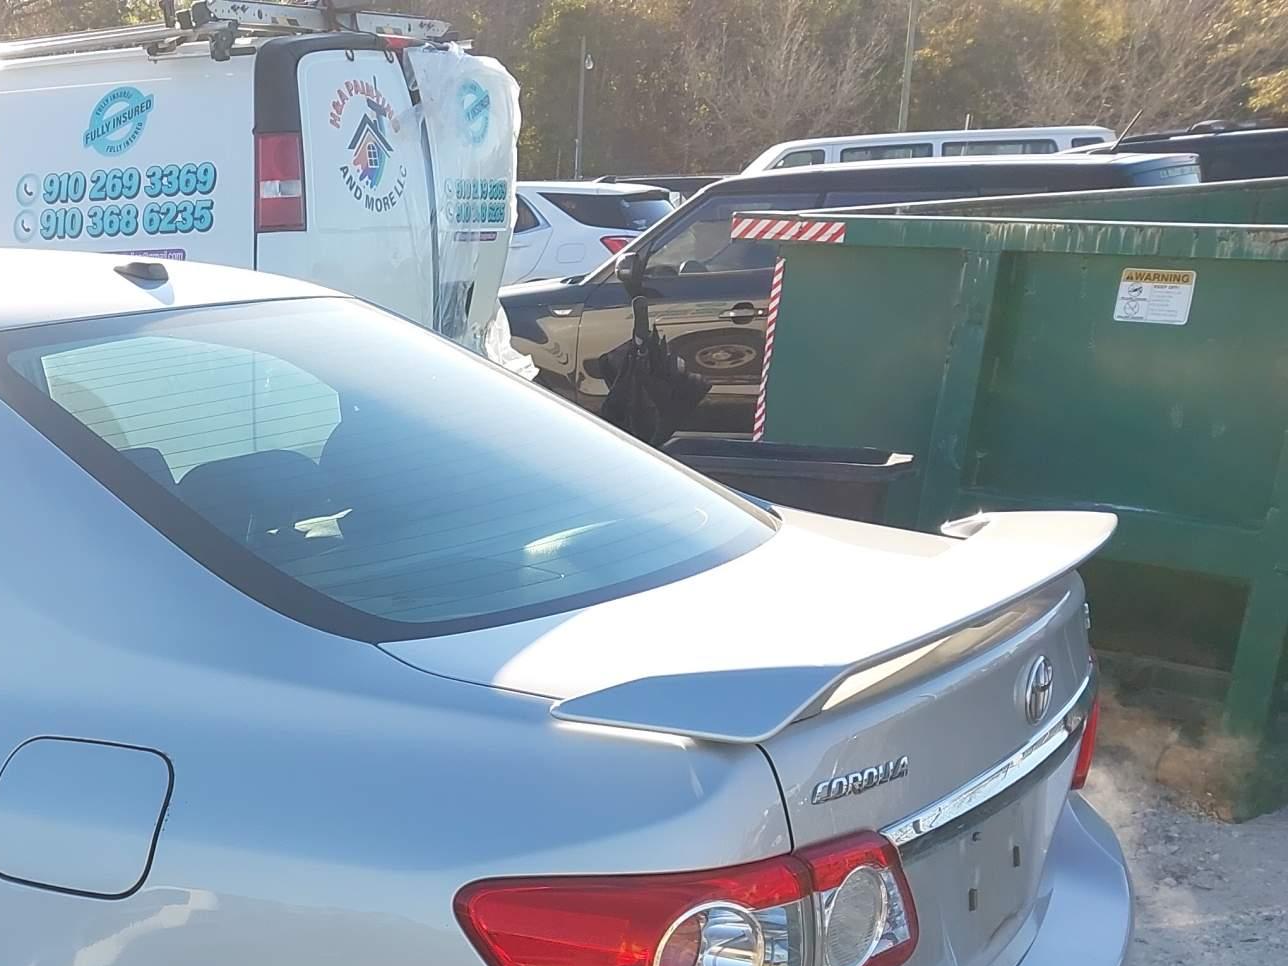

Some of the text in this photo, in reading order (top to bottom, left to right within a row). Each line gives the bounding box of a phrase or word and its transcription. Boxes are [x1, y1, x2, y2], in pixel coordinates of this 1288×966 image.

[85, 99, 152, 145] FULLY INSURED
[43, 161, 217, 205] 910 269 3369
[339, 164, 408, 213] AND MORE LLC
[40, 199, 215, 241] 910 368 6235
[1134, 271, 1190, 284] WARNING
[811, 755, 909, 805] COROLLA
